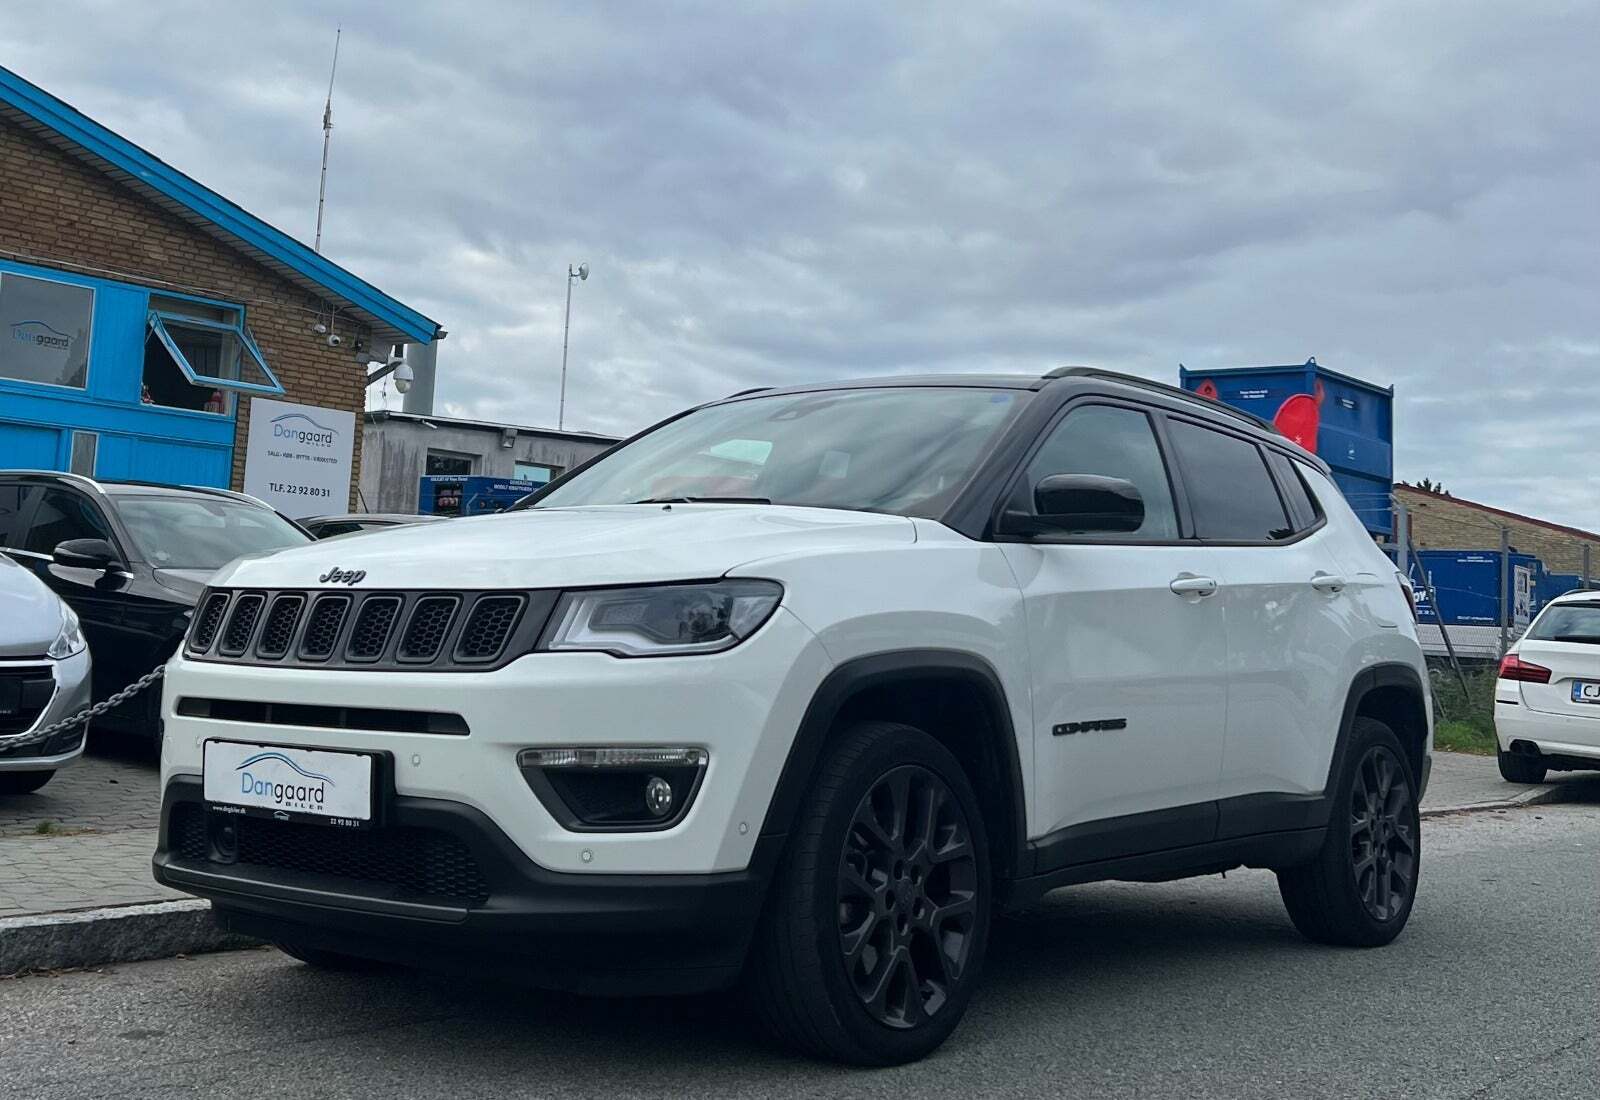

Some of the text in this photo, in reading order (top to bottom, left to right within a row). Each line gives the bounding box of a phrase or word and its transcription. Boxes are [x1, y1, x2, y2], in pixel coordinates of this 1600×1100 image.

[273, 424, 332, 444] Dangaard
[269, 482, 330, 497] TLF. 22 92 80 31
[319, 566, 367, 586] Jeep
[241, 772, 324, 804] Dangaard
[285, 801, 323, 811] BILER
